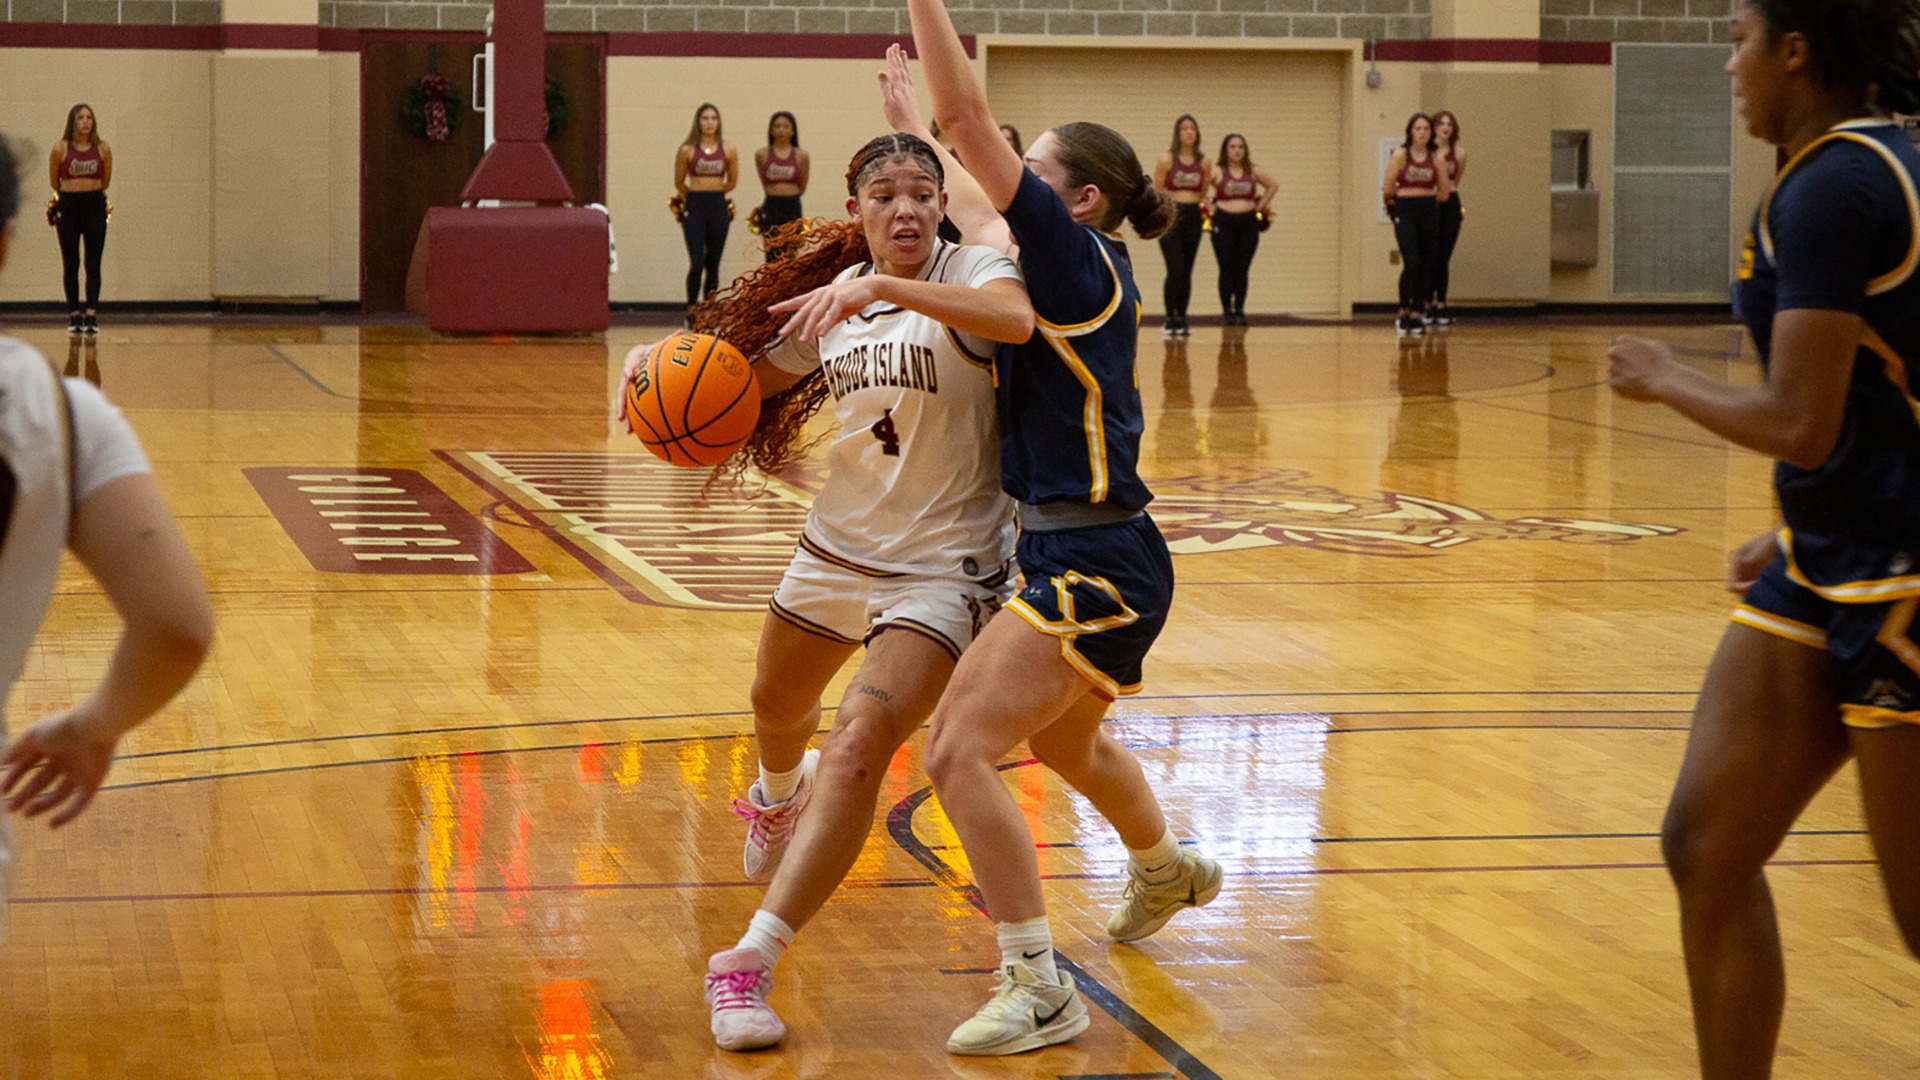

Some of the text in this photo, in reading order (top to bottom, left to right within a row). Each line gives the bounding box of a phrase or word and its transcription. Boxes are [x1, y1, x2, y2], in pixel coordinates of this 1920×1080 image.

[824, 342, 938, 402] RHODE ISLAND
[871, 408, 899, 456] 4
[287, 474, 479, 561] COLLEGE
